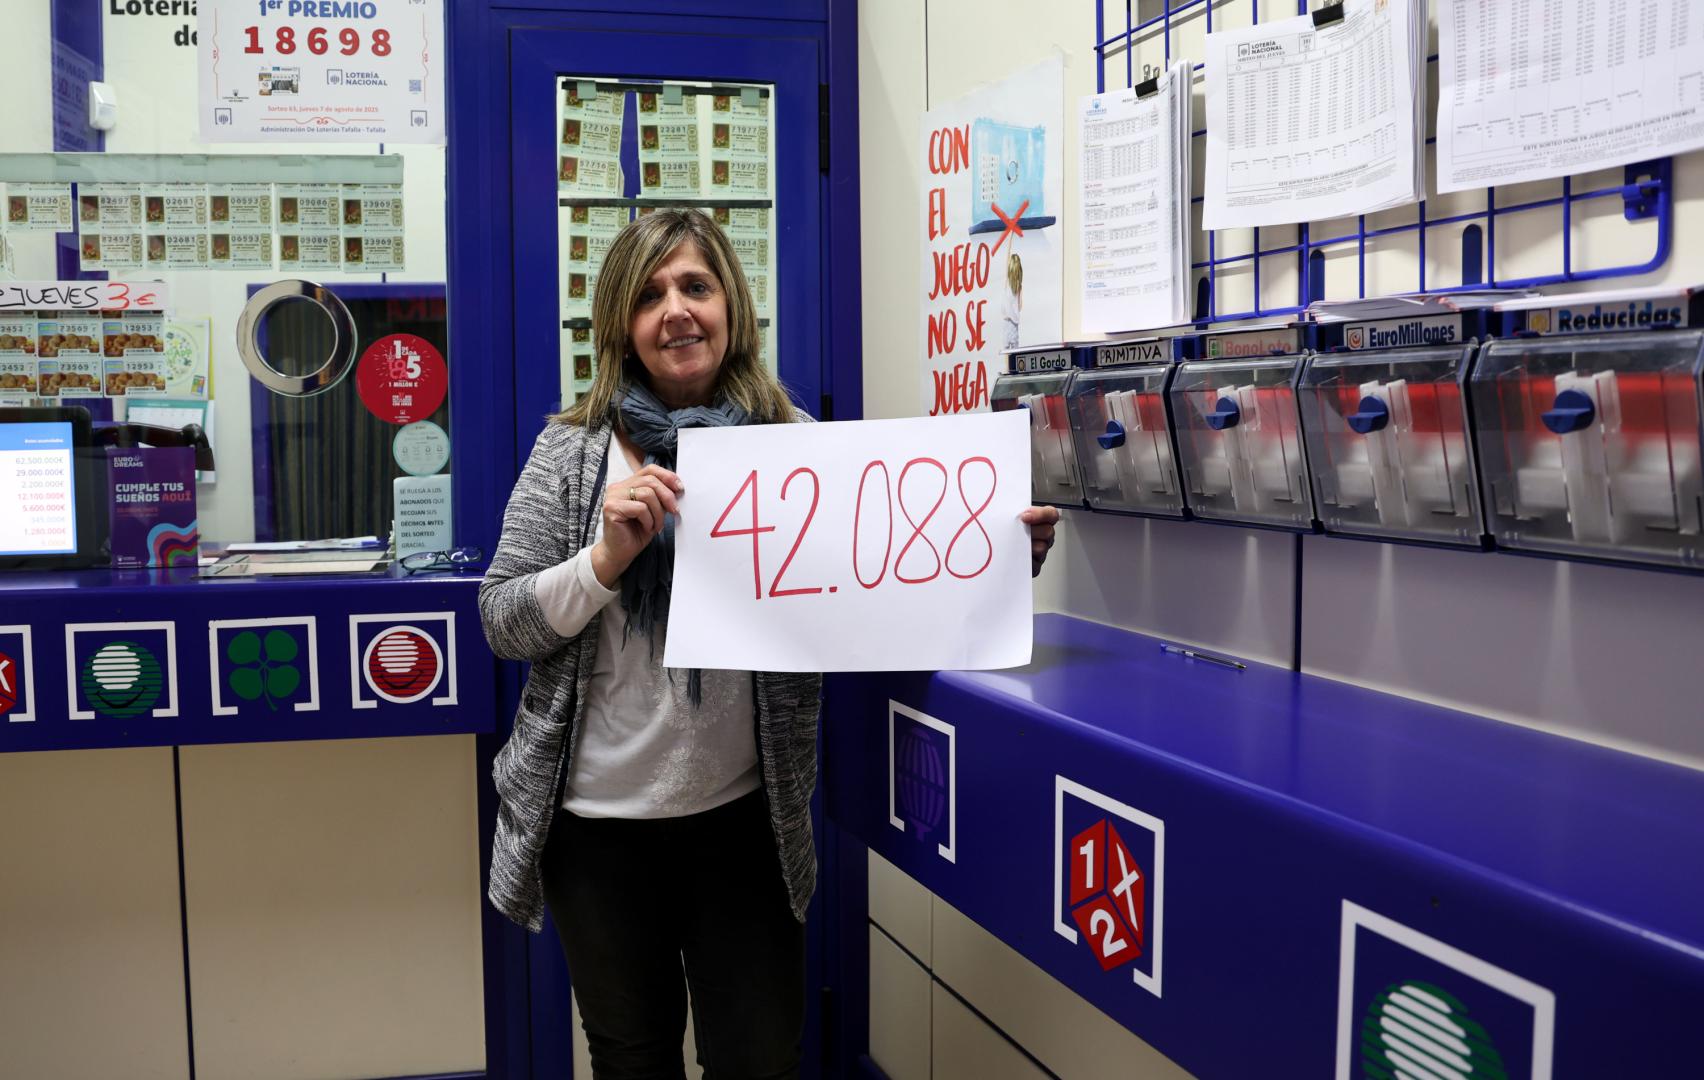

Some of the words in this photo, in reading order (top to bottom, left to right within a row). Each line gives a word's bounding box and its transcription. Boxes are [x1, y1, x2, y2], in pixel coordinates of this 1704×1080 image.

[259, 0, 283, 17] 1er
[289, 0, 377, 19] PREMIO
[244, 26, 392, 56] 18698
[1251, 40, 1276, 50] LOTERÍA
[1251, 45, 1283, 54] NACIONAL
[345, 71, 379, 79] LOTERÍA
[345, 78, 388, 86] NACIONAL
[929, 124, 969, 174] CON
[929, 188, 950, 241] EL
[929, 242, 991, 301] JUEGO
[6, 286, 99, 308] JUEVES
[928, 308, 957, 359] NO
[965, 300, 987, 352] SE
[1558, 304, 1682, 332] Reducidas
[1369, 322, 1455, 348] EuroMillones
[393, 340, 402, 359] 1
[1100, 345, 1162, 363] PRIMITIVA
[407, 355, 421, 379] 5
[1030, 356, 1037, 369] El
[1040, 354, 1066, 370] Gordo
[930, 361, 990, 416] JUEGA
[115, 483, 160, 492] CUMPLE
[162, 482, 184, 491] TUS
[116, 491, 160, 503] SUEÑOS
[710, 456, 997, 600] 42.088
[1079, 839, 1094, 889] 1
[1090, 908, 1128, 958] 2
